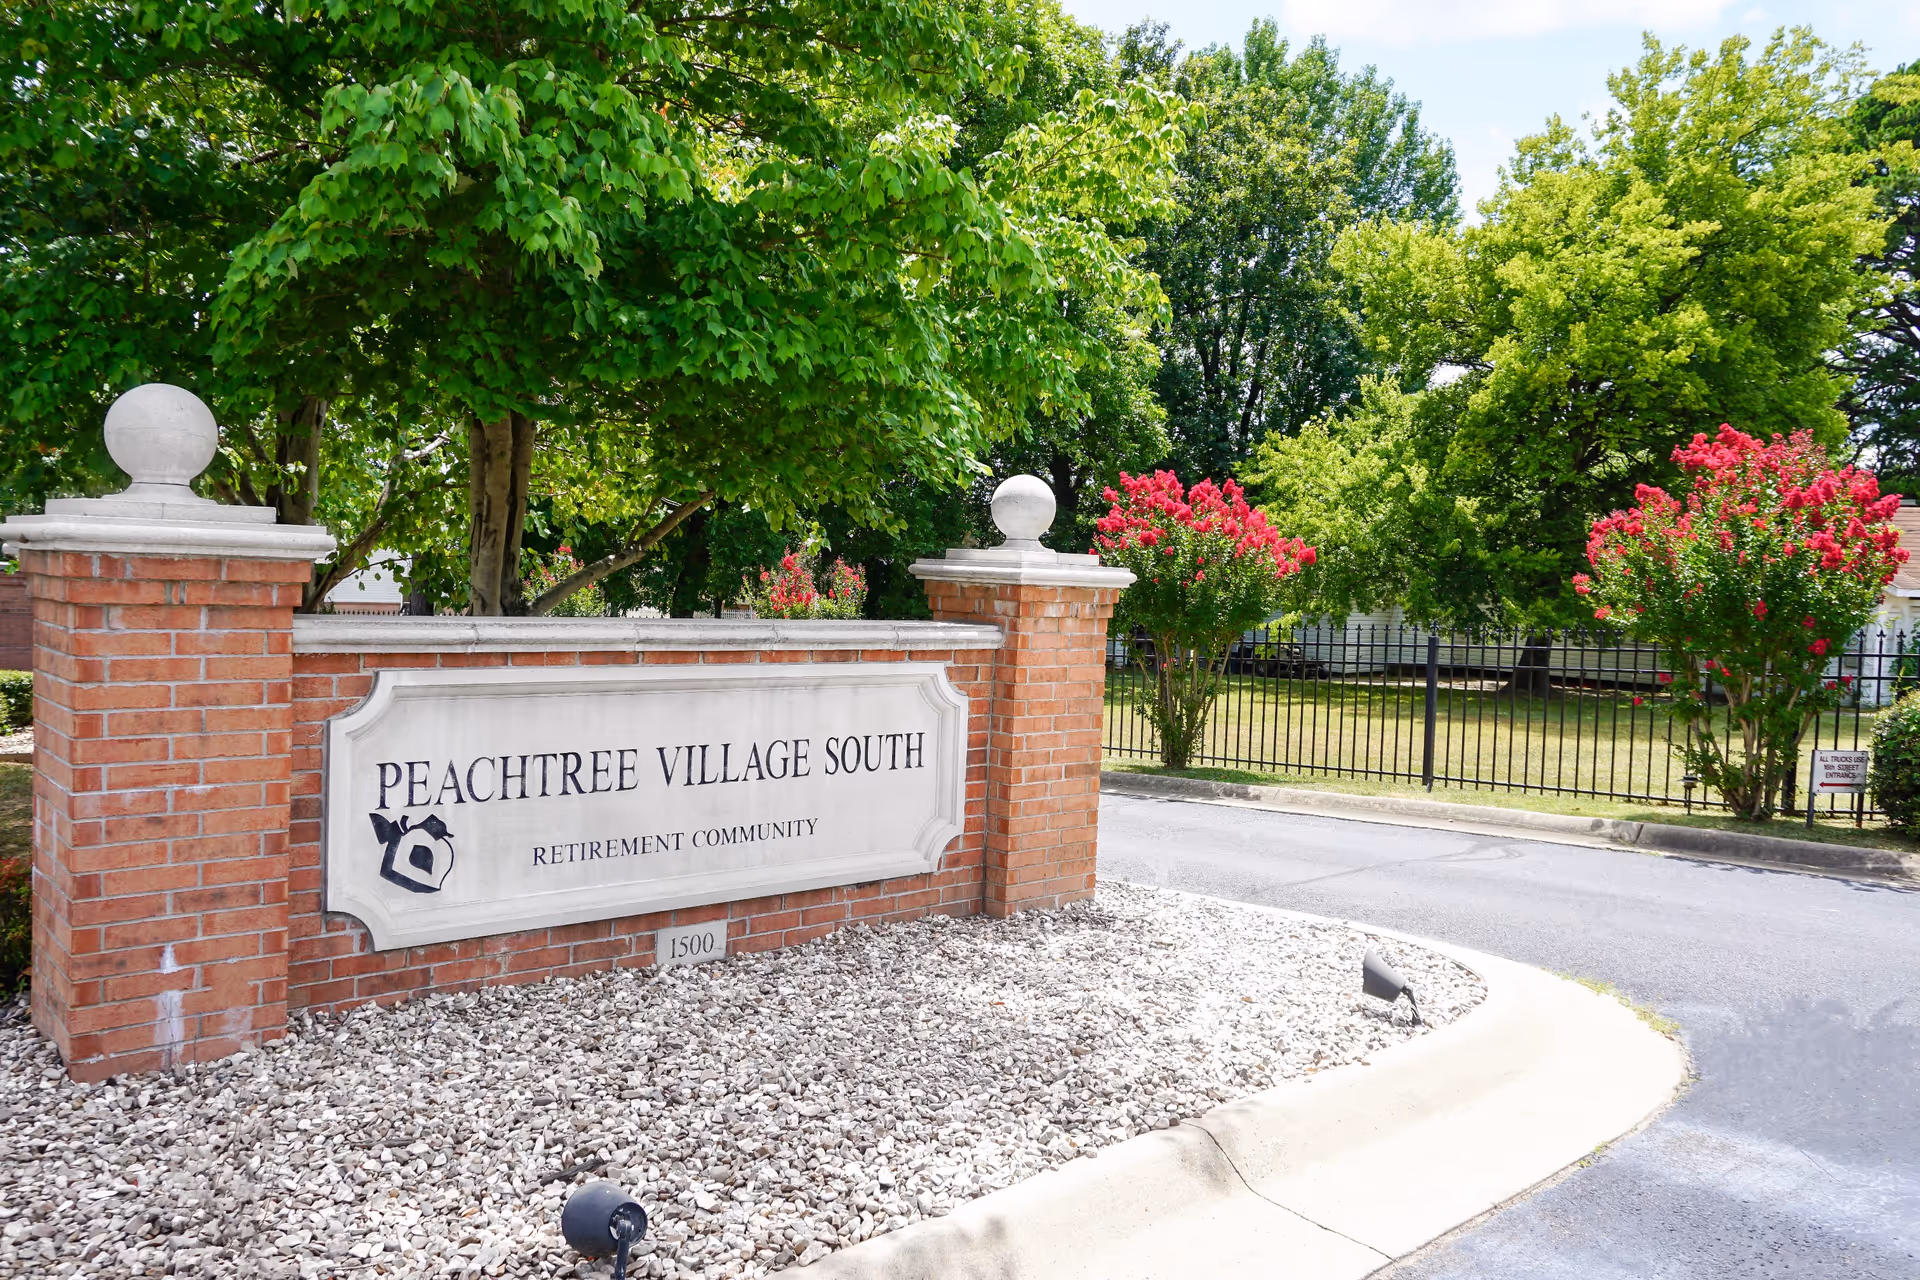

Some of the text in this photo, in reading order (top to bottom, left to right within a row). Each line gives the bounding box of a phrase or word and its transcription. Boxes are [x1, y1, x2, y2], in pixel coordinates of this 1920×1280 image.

[374, 732, 925, 811] PEACHTREE VILLAGE SOUTH
[533, 818, 819, 866] RETIREMENT COMMUNITY
[669, 932, 715, 960] 1500
